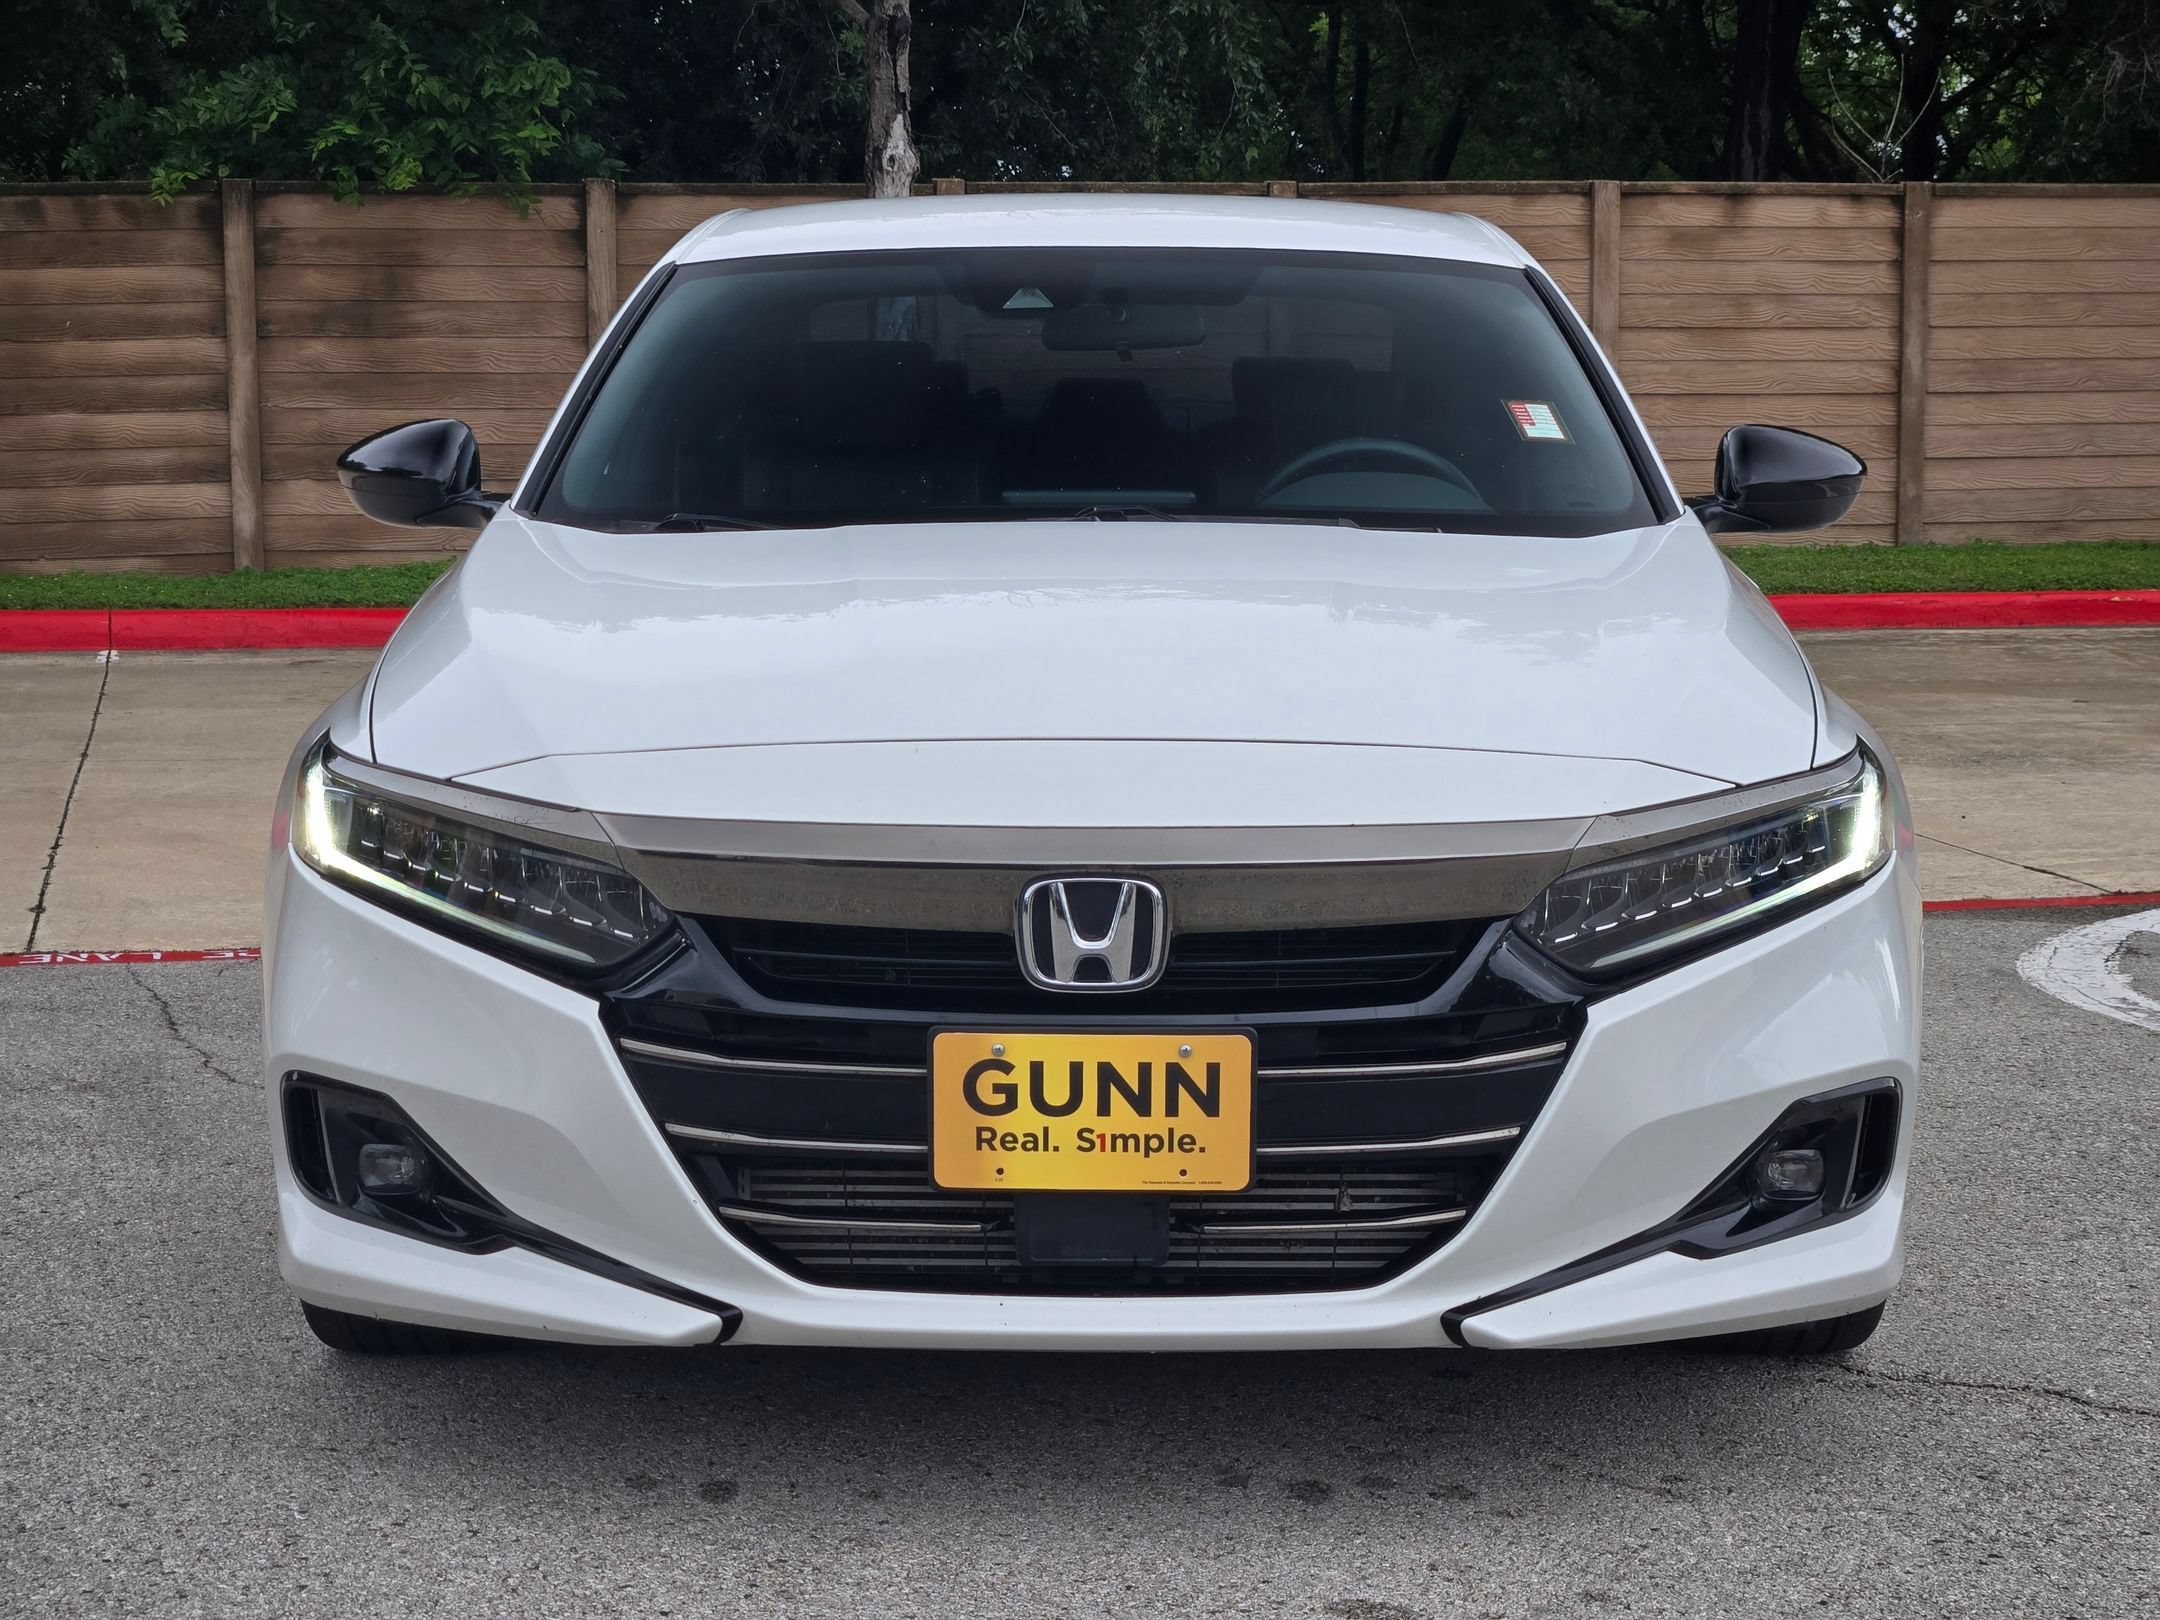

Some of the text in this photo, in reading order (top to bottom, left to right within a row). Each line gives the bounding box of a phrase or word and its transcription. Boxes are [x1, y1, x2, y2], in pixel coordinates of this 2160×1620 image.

[18, 952, 162, 965] LANE
[962, 1058, 1221, 1118] GUNN
[975, 1126, 1206, 1158] Real. S1mple.
